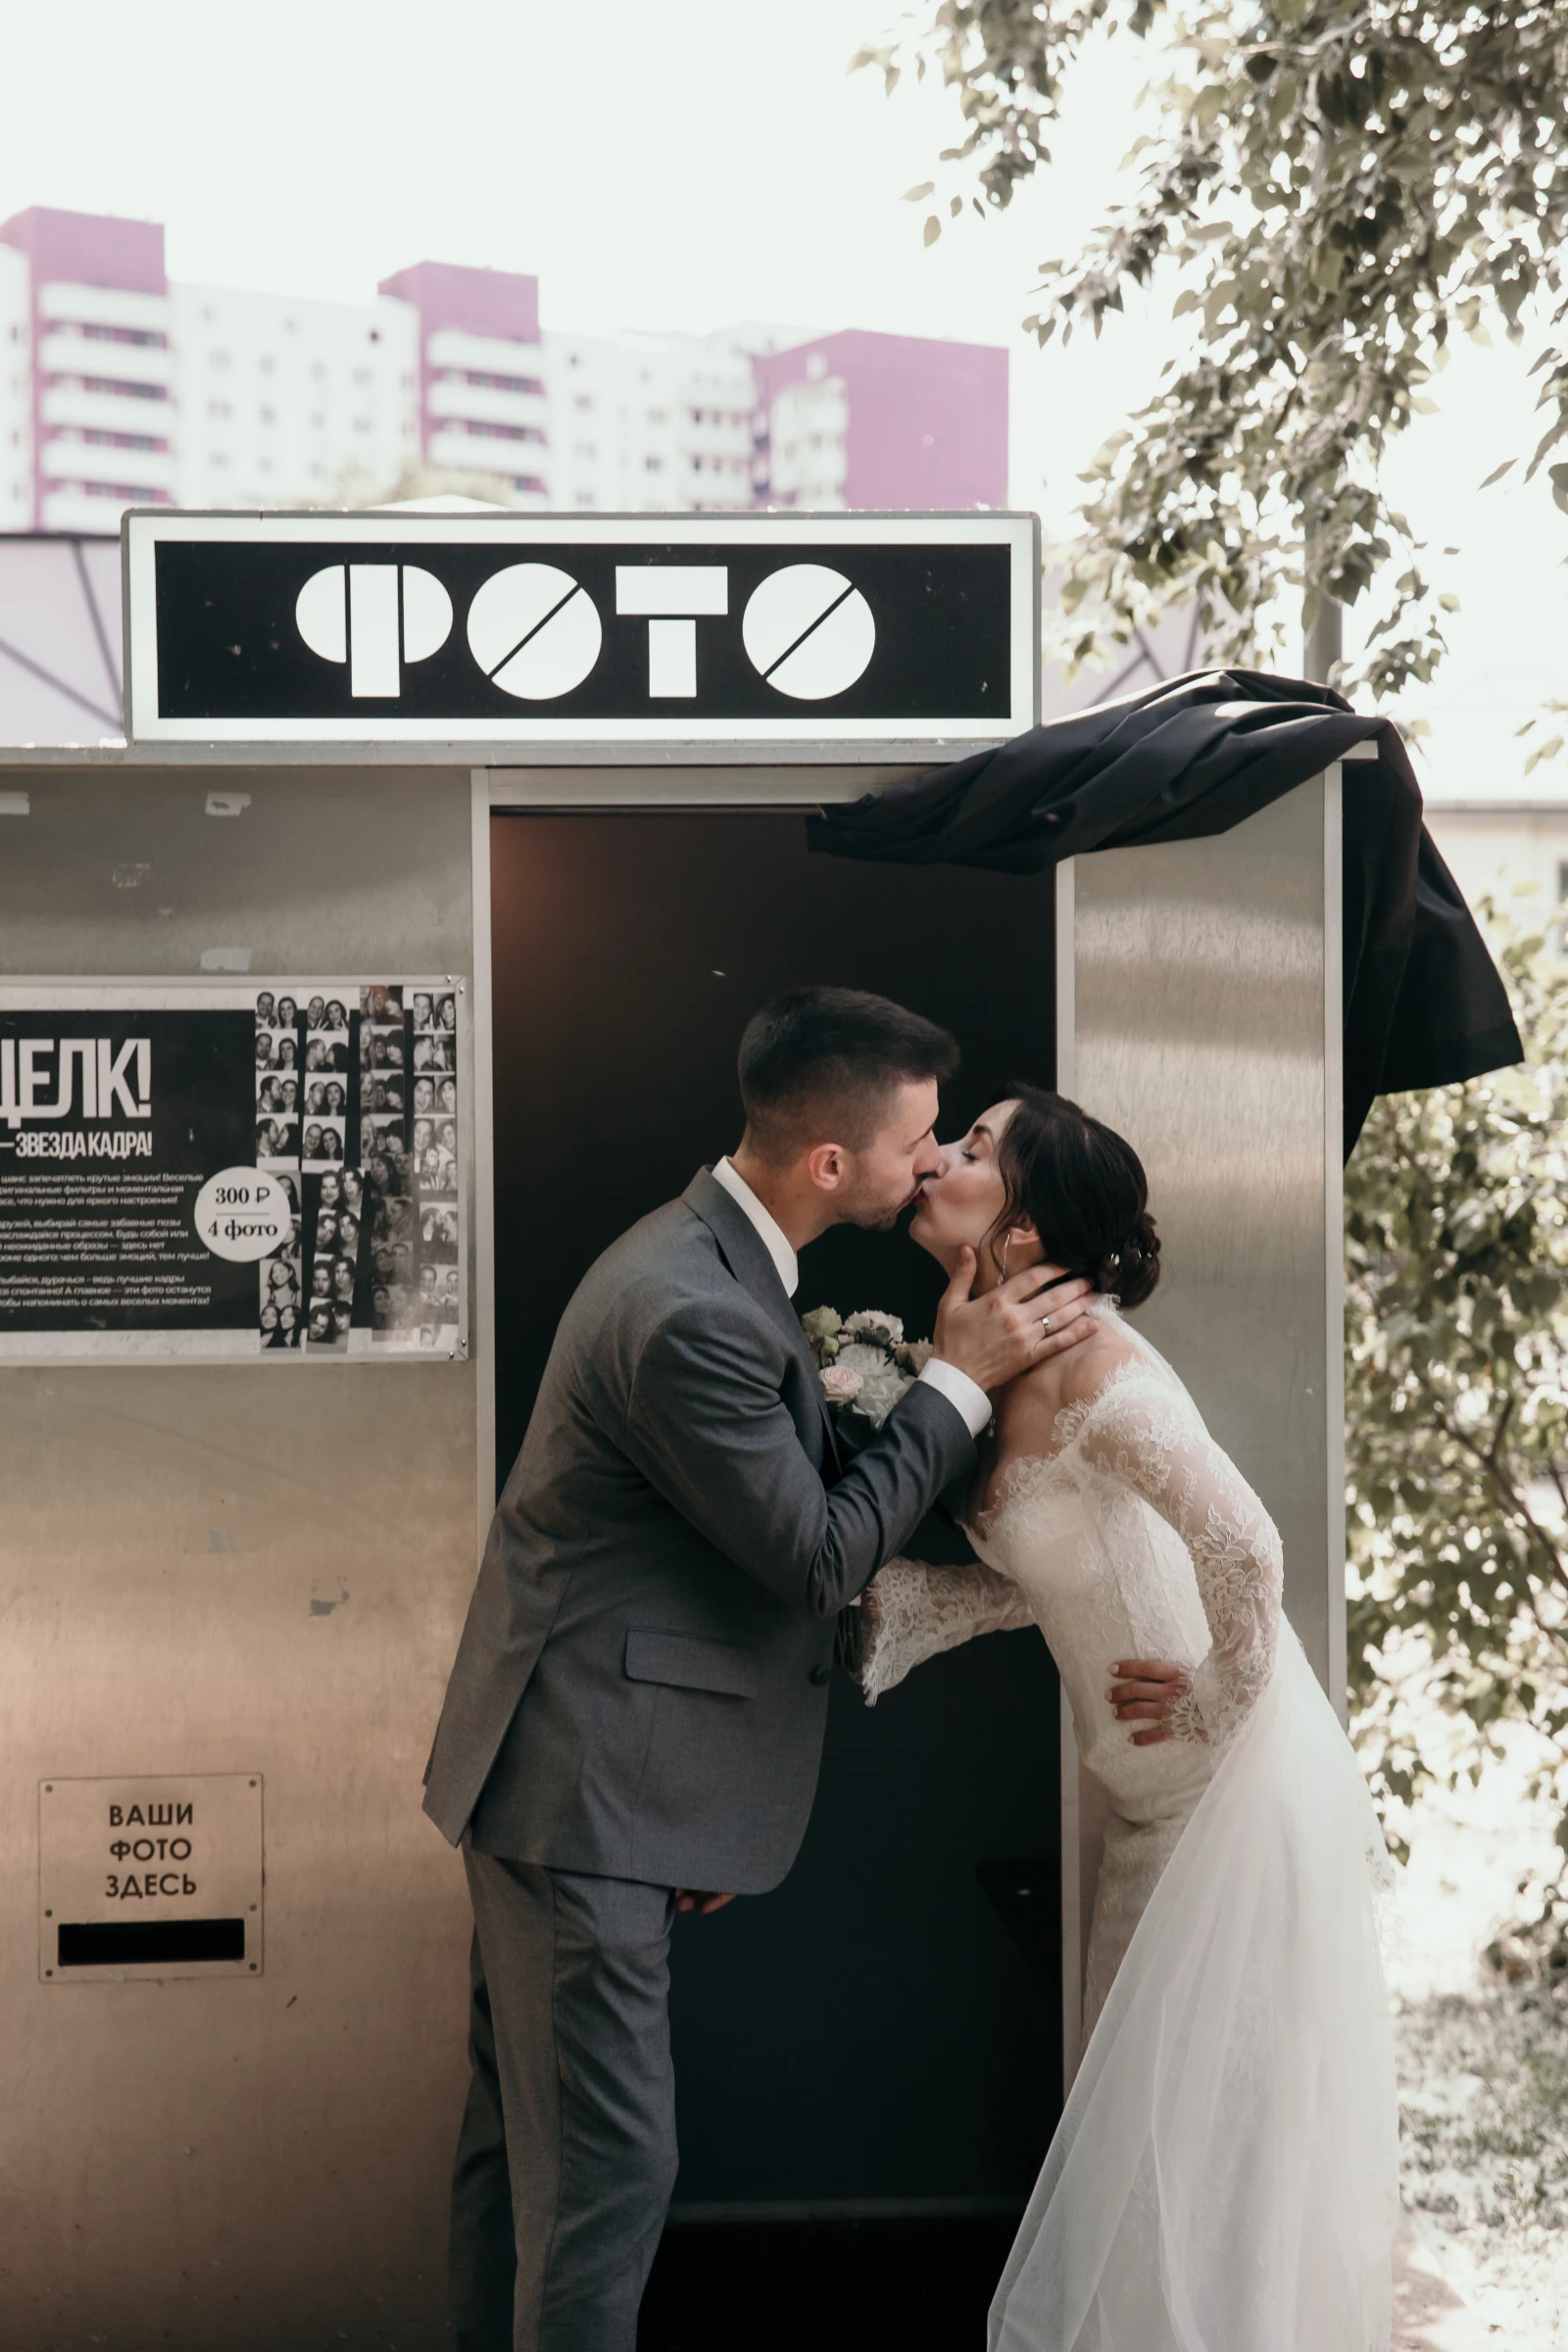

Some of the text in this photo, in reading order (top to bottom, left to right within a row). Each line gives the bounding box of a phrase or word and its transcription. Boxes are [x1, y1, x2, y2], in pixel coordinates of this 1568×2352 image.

[296, 563, 876, 700] ФОТО
[16, 1131, 153, 1159] ЗВЕЗДА КАДРА!
[28, 1175, 85, 1184] запечатлеть
[86, 1175, 121, 1185] крутые
[122, 1173, 161, 1183] эмоции!
[163, 1173, 204, 1182] Веселые
[64, 1185, 107, 1196] фильтры
[116, 1185, 184, 1194] моментальная
[216, 1187, 249, 1204] 300
[34, 1198, 66, 1207] нужно
[67, 1198, 85, 1206] для
[86, 1197, 119, 1206] яркого
[121, 1196, 178, 1206] настроения!
[33, 1218, 76, 1229] выбирай
[110, 1217, 156, 1227] забавные
[116, 1229, 139, 1240] Будь
[140, 1229, 169, 1238] собой
[208, 1219, 278, 1241] 4 фото
[3, 1242, 72, 1250] неожиданные
[73, 1241, 108, 1250] образы
[80, 1251, 117, 1261] больше
[177, 1251, 211, 1261] лучше!
[41, 1276, 85, 1286] дурачься
[92, 1276, 116, 1285] ведь
[117, 1275, 154, 1285] лучшие
[155, 1275, 185, 1284] кадры
[65, 1286, 73, 1295] А
[141, 1285, 165, 1295] фото
[166, 1286, 212, 1296] останутся
[89, 1298, 119, 1306] самых
[121, 1297, 160, 1305] веселых
[162, 1296, 211, 1305] моментах!
[109, 1803, 194, 1827] ВАШИ
[109, 1838, 192, 1862] ФОТО
[105, 1873, 197, 1899] ЗДЕСЬ
